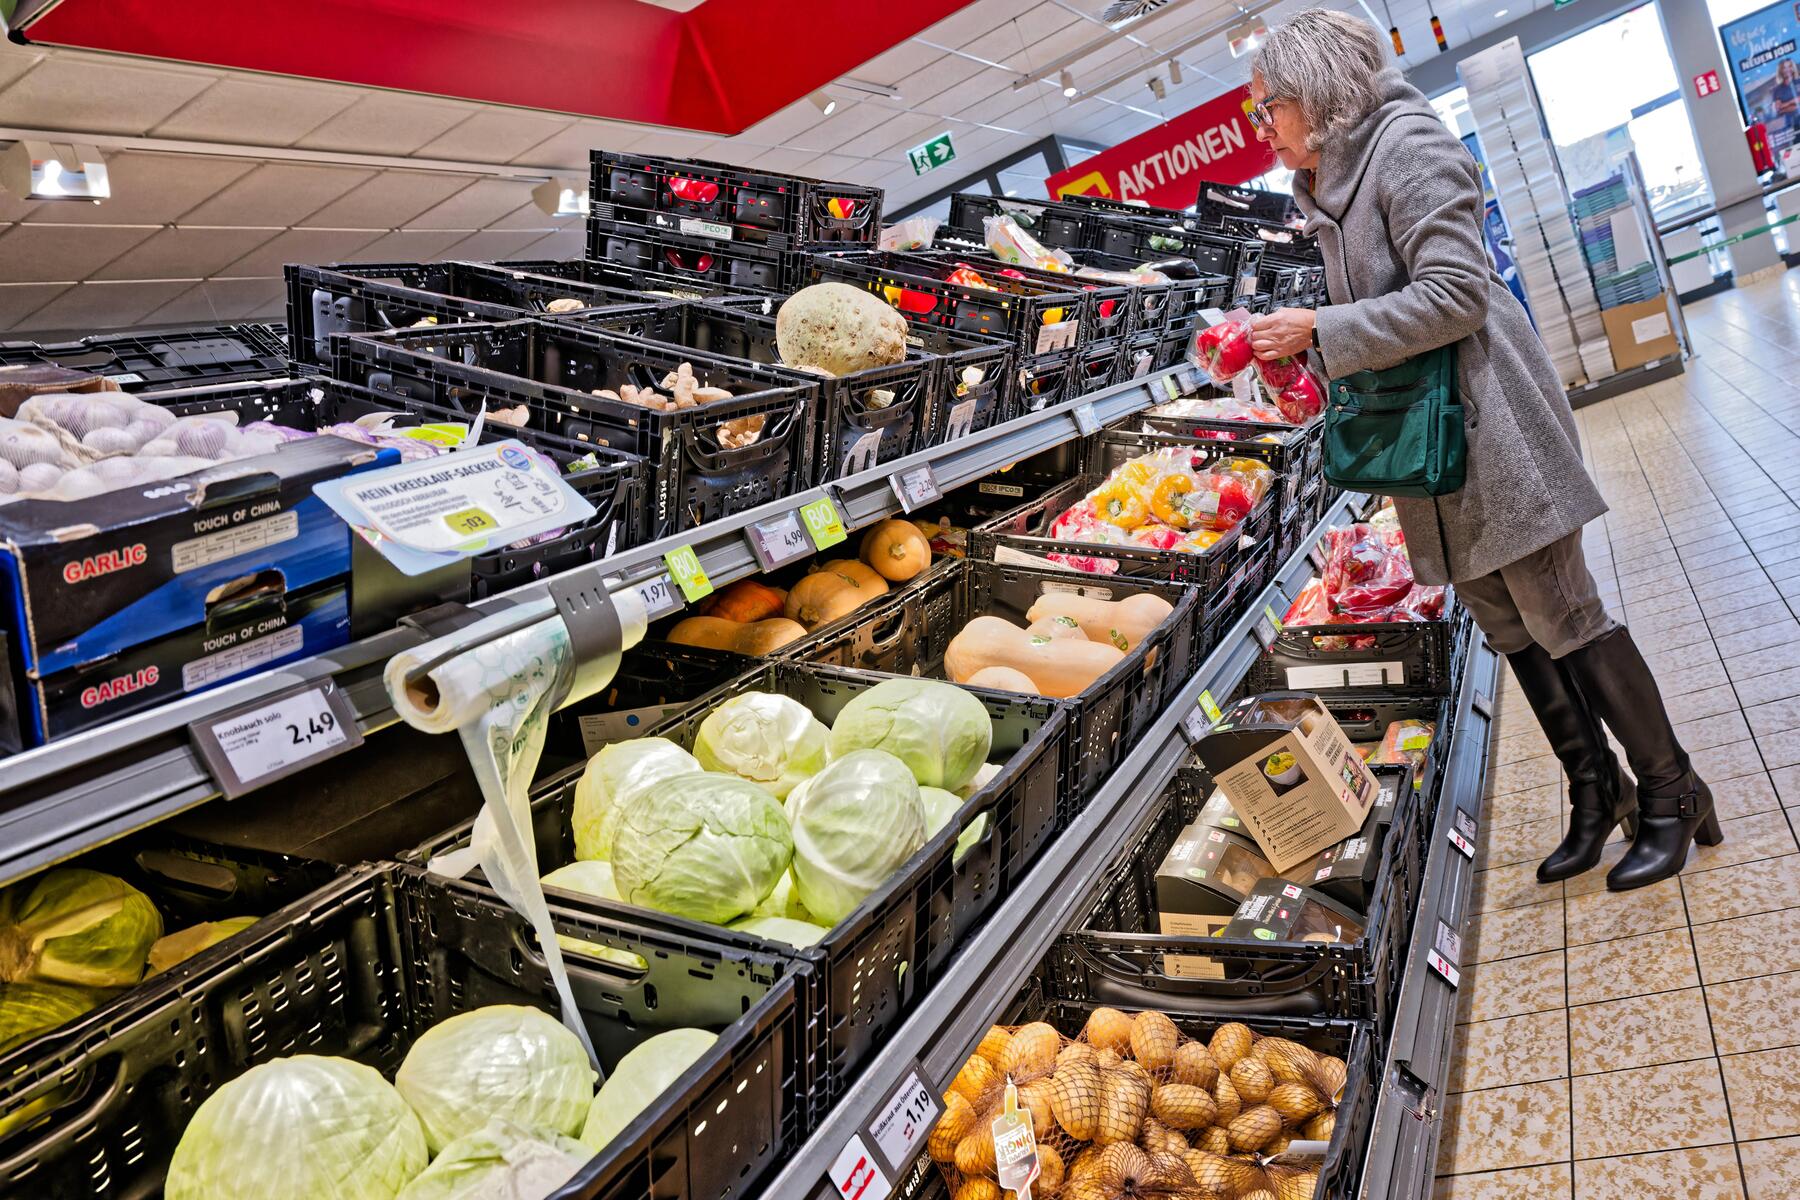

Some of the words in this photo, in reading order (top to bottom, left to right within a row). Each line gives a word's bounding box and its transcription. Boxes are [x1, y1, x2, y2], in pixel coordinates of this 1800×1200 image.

[1118, 117, 1246, 202] AKTIONEN
[356, 485, 392, 502] MEIN
[393, 457, 505, 494] KREISLAUF-SACKERL
[193, 515, 228, 534] TOUCH
[232, 508, 247, 523] OF
[250, 499, 282, 517] CHINA
[658, 480, 668, 520] LL4314
[808, 503, 833, 531] BIO
[784, 530, 804, 549] 4,99
[63, 543, 148, 585] GARLIC
[673, 552, 698, 581] BIO
[640, 582, 668, 603] 1,97
[203, 632, 237, 652] TOUCH
[240, 626, 255, 640] OF
[257, 615, 287, 633] CHINA
[81, 665, 160, 708] GARLIC
[217, 717, 264, 741] Knoblauch
[264, 711, 282, 723] solo
[286, 711, 335, 745] 2,49
[873, 1112, 895, 1139] Weißkraut
[894, 1103, 902, 1114] aus
[900, 1078, 920, 1103] Österreich
[906, 1089, 930, 1124] 1,19
